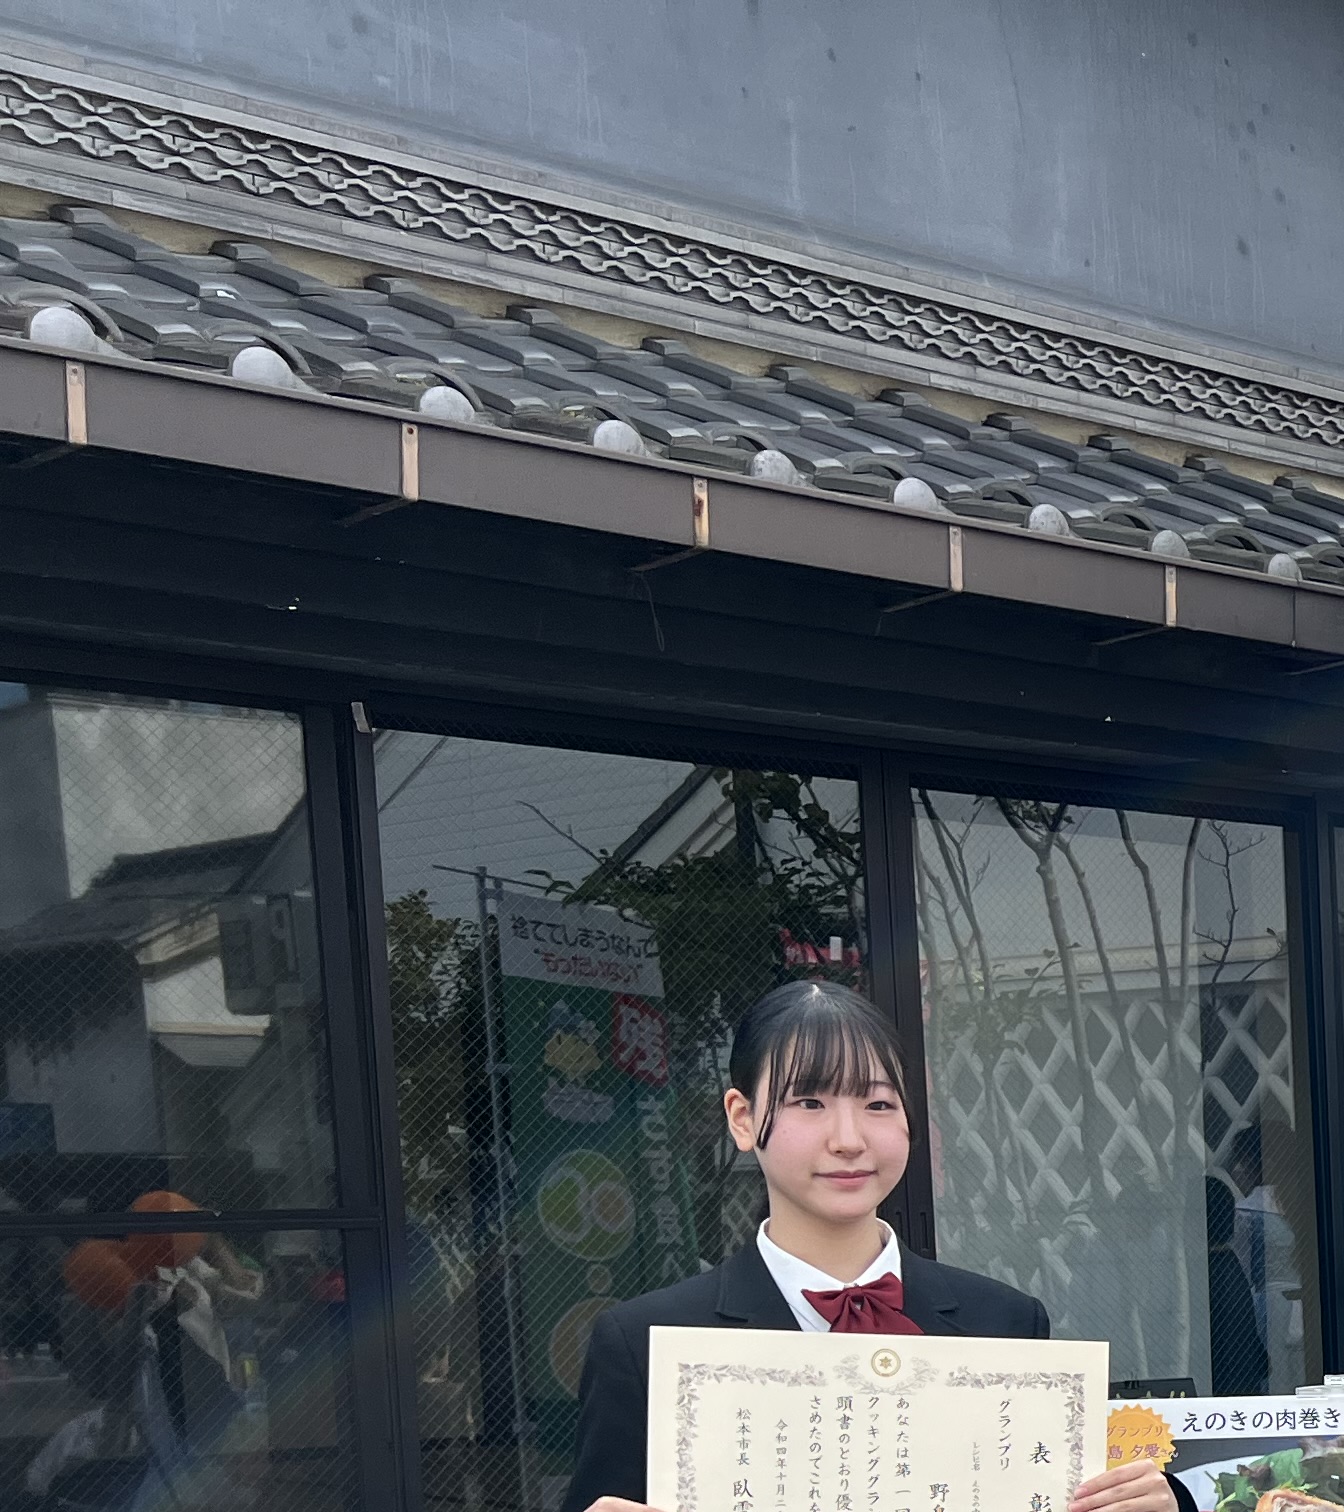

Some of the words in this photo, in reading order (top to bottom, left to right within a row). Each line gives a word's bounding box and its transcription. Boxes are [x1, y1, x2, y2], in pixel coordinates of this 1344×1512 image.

[736, 1407, 751, 1466] 松本市長
[998, 1398, 1011, 1470] グランプリ
